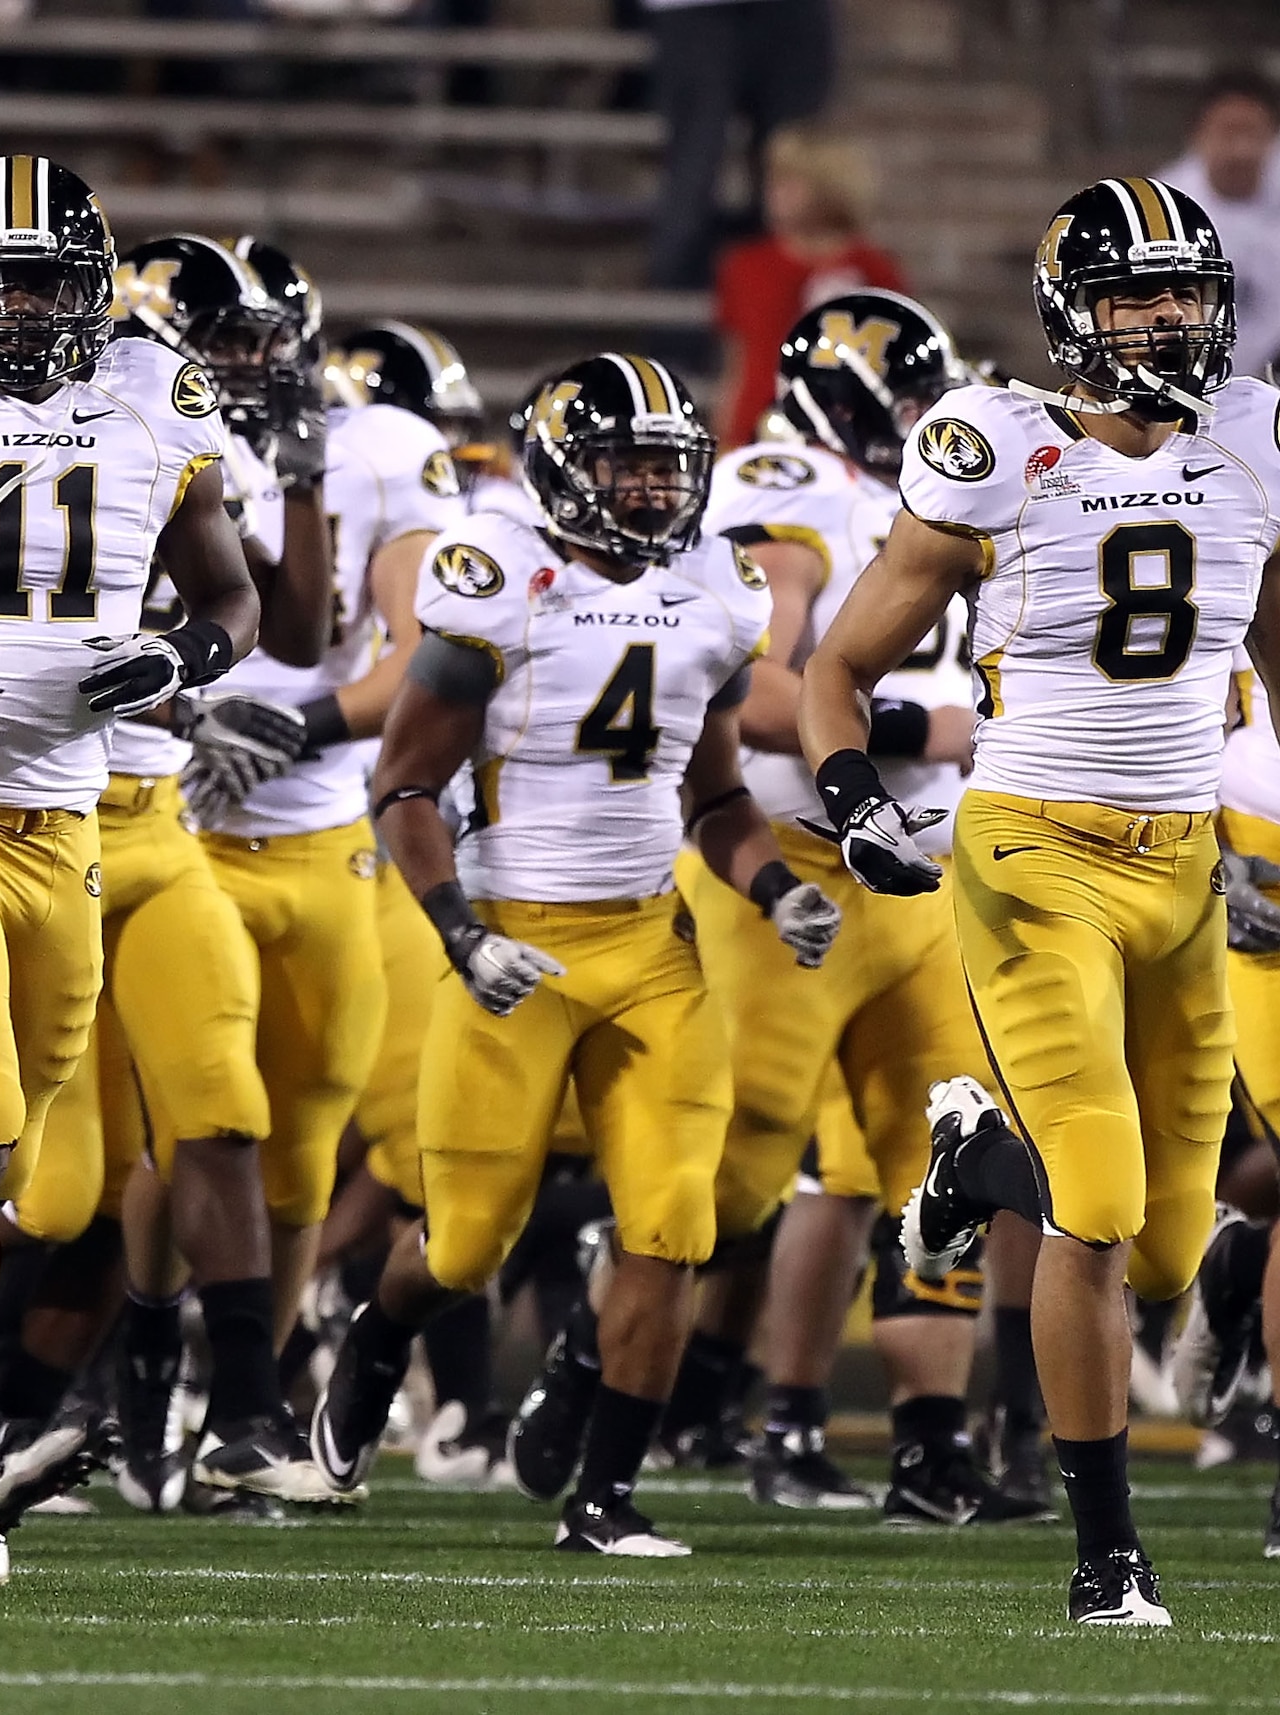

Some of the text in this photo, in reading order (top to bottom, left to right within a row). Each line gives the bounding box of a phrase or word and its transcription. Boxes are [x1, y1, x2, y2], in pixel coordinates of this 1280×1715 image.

[106, 259, 182, 321] M
[808, 311, 901, 378] M
[1081, 492, 1205, 513] MIZZOU
[573, 613, 680, 628] MIZZOU
[1091, 520, 1201, 685] 8
[573, 642, 660, 783] 4
